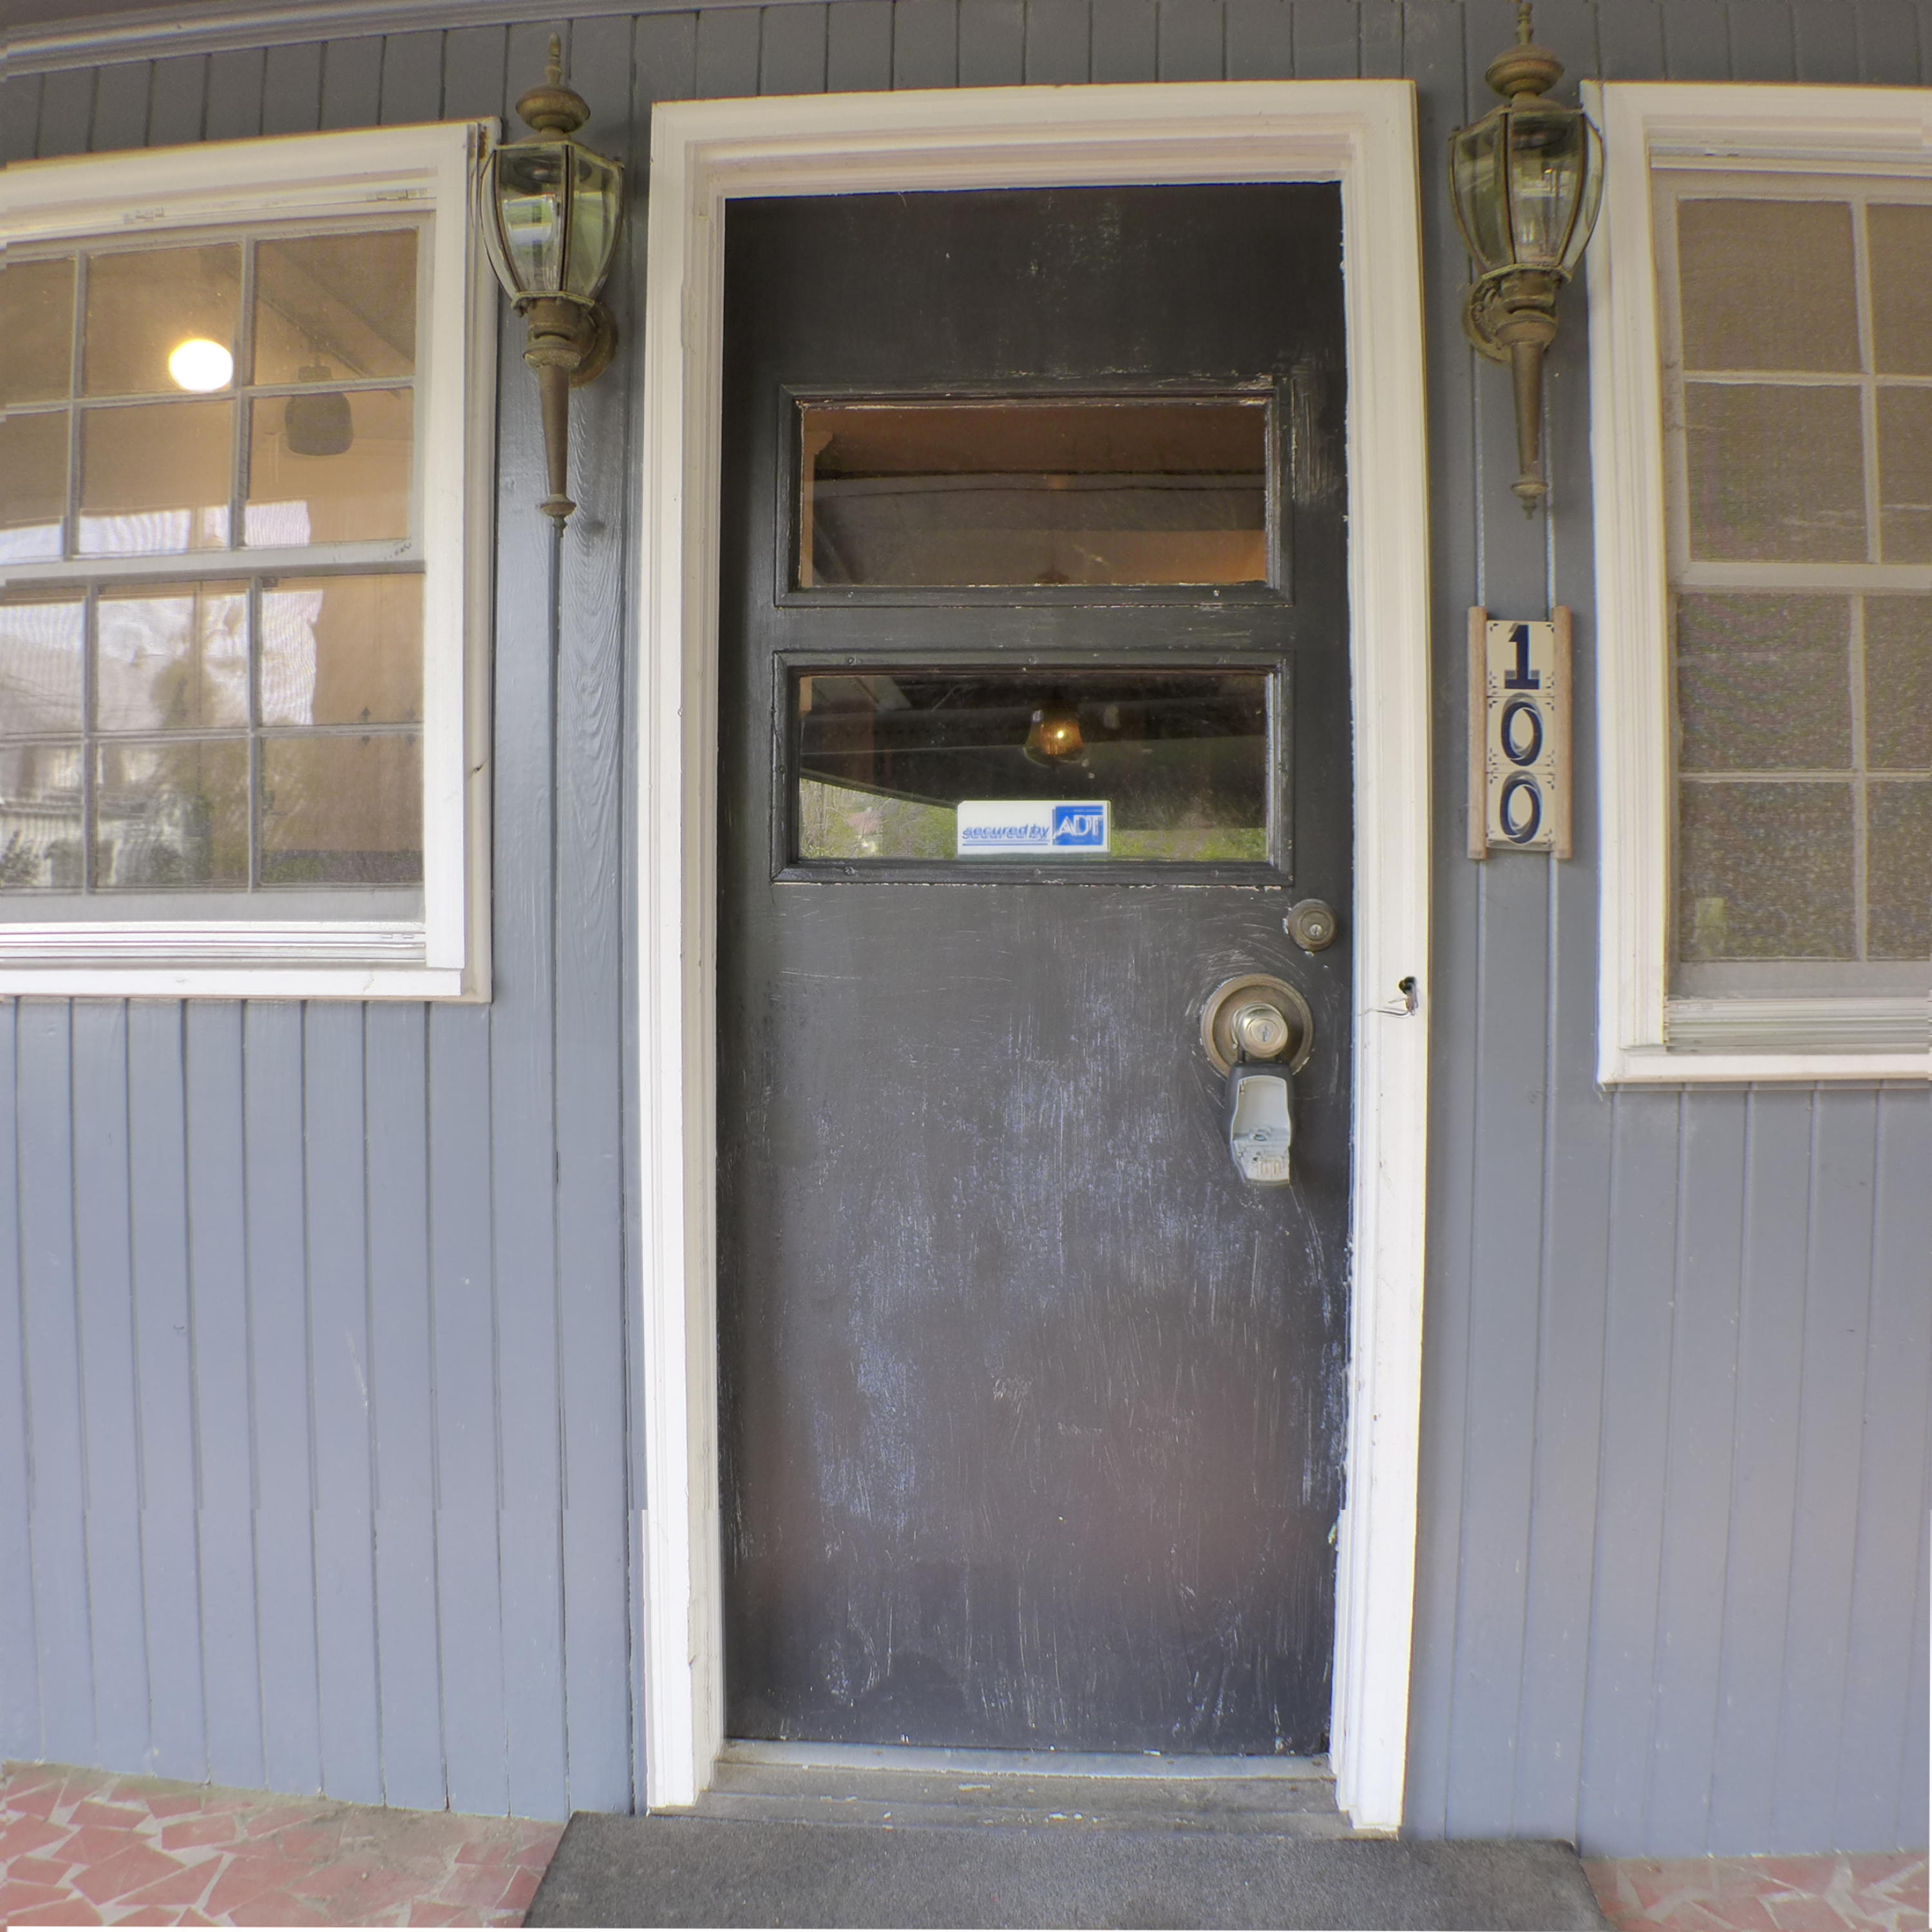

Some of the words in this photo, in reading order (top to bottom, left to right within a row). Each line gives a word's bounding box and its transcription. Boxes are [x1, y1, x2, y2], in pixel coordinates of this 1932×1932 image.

[1499, 624, 1543, 844] 100
[962, 824, 1028, 840] secured
[1028, 824, 1050, 841] by
[1053, 814, 1104, 840] ADT
